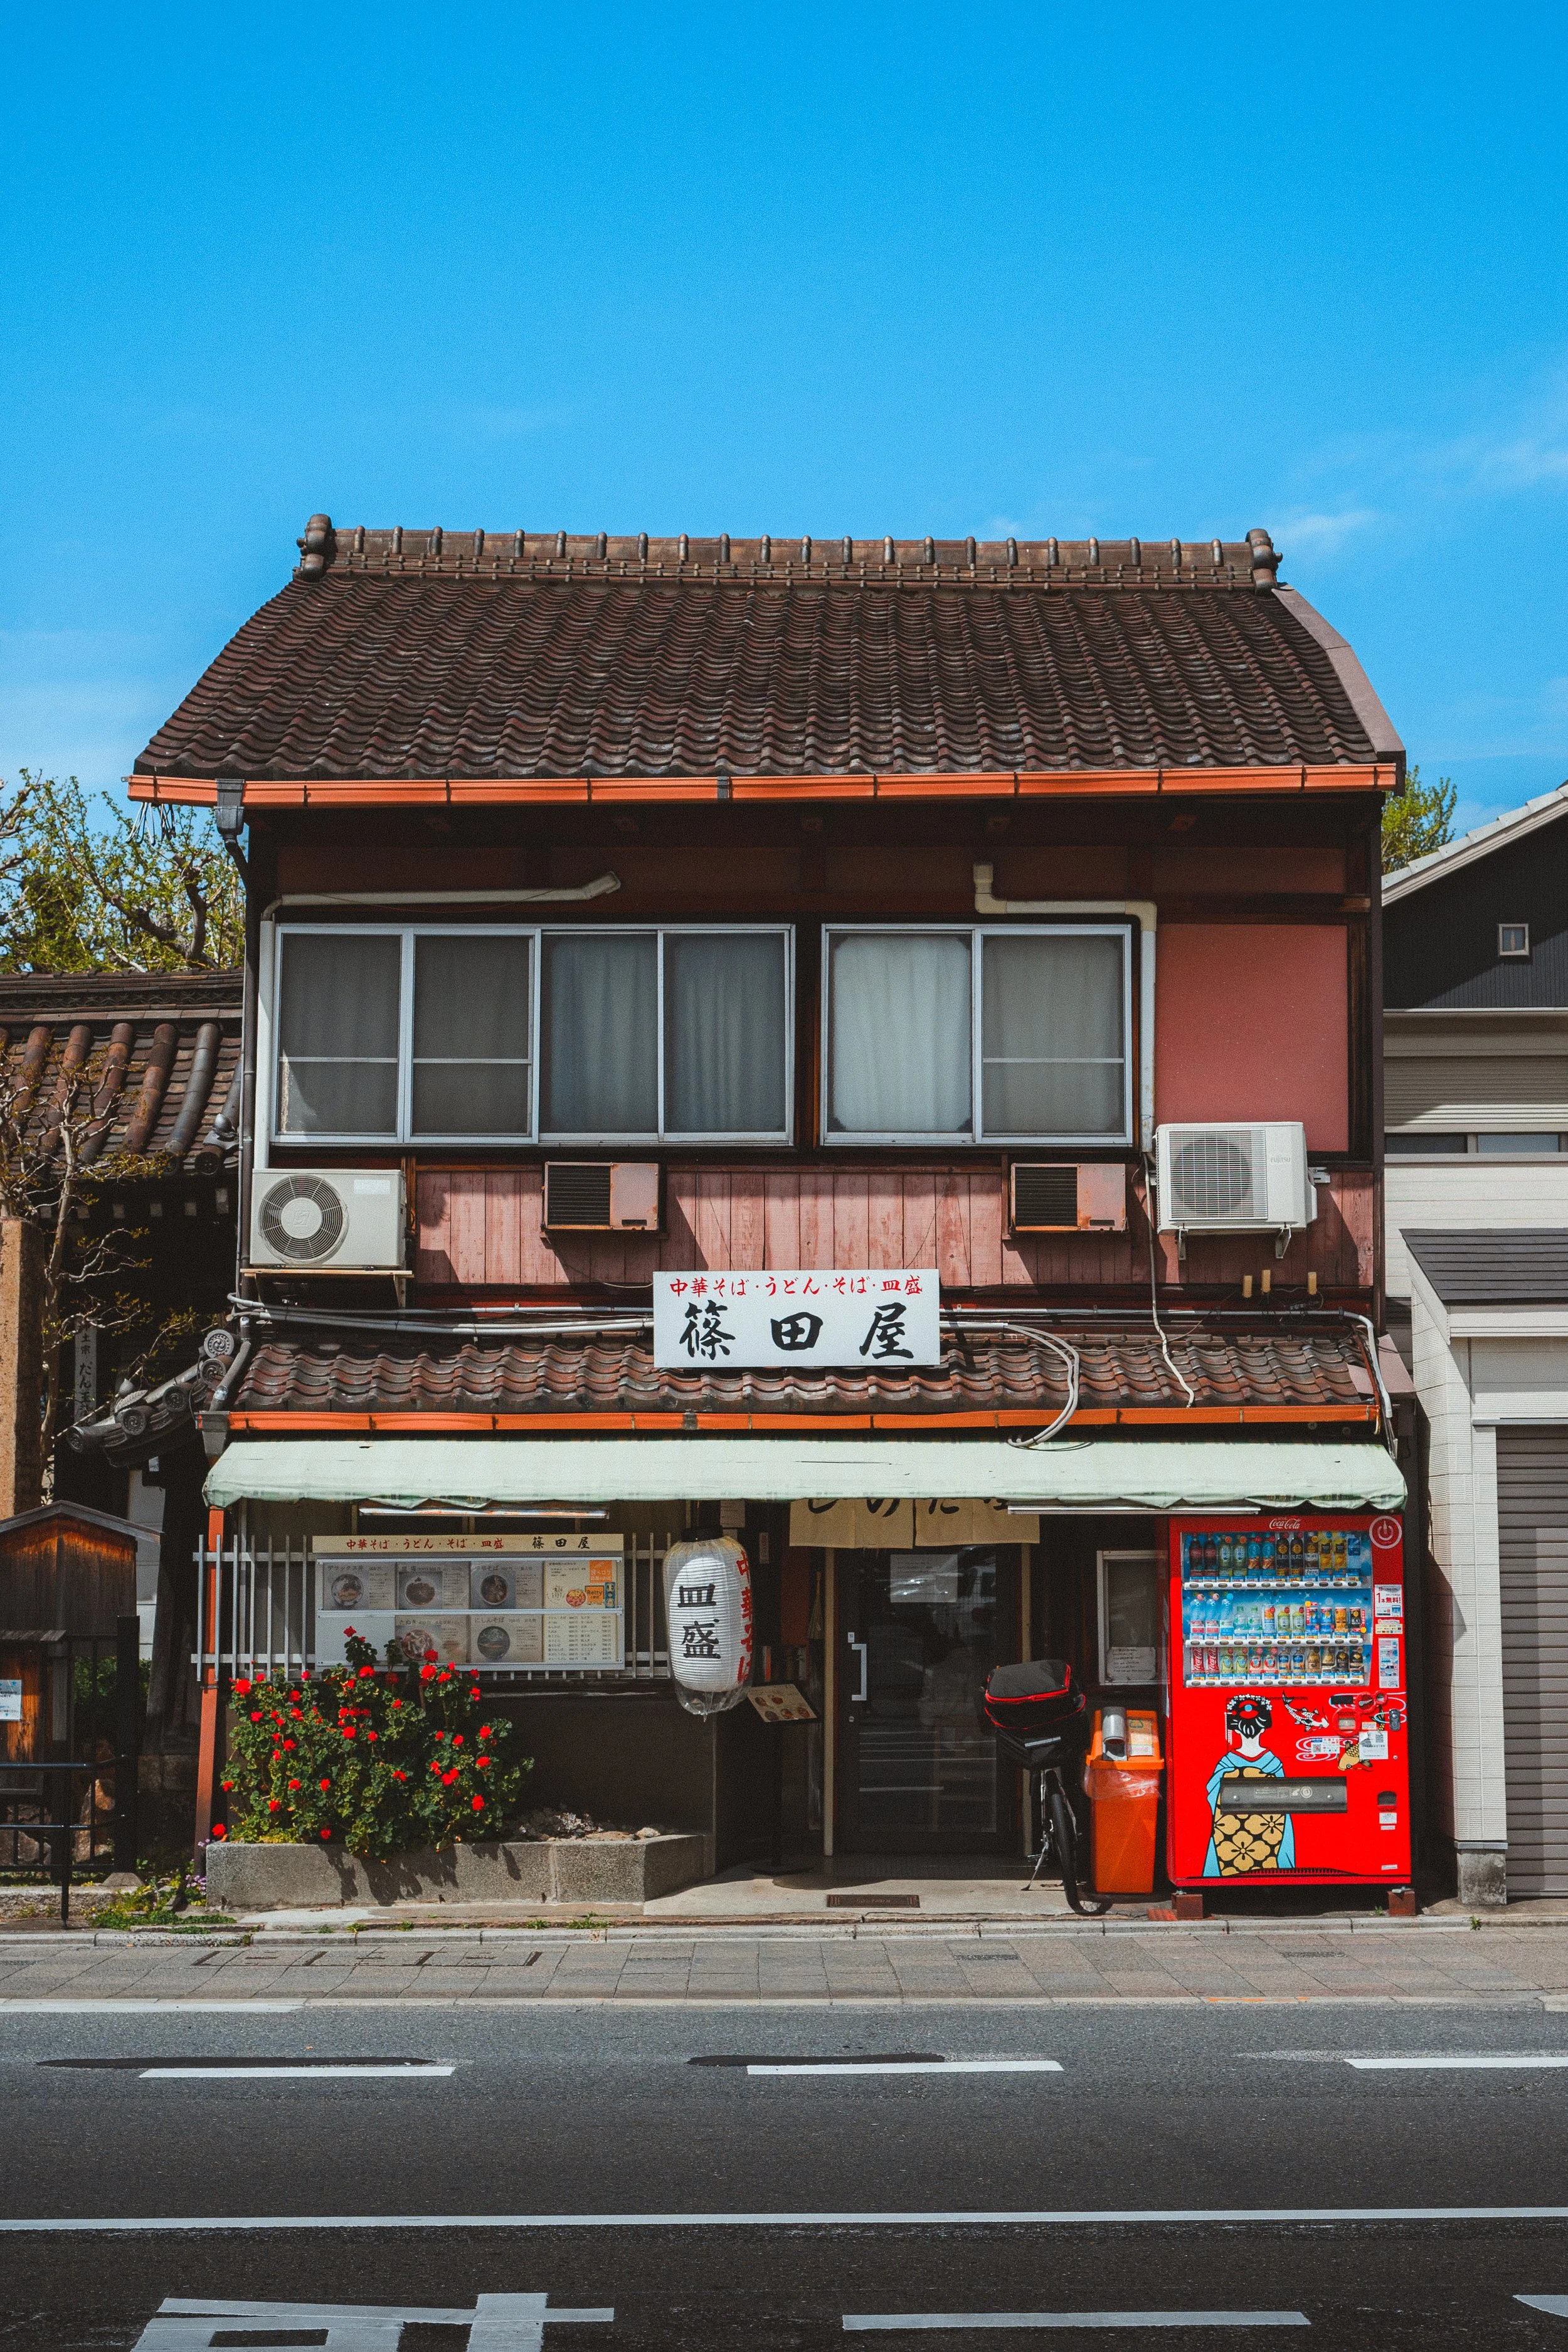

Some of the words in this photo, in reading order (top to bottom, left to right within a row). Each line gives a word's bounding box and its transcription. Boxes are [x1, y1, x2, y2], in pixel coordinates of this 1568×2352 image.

[680, 1300, 914, 1360] 篠田屋
[1269, 1518, 1301, 1529] Coca-Cola
[532, 1536, 590, 1549] 篠田屋
[677, 1583, 721, 1659] 皿盛
